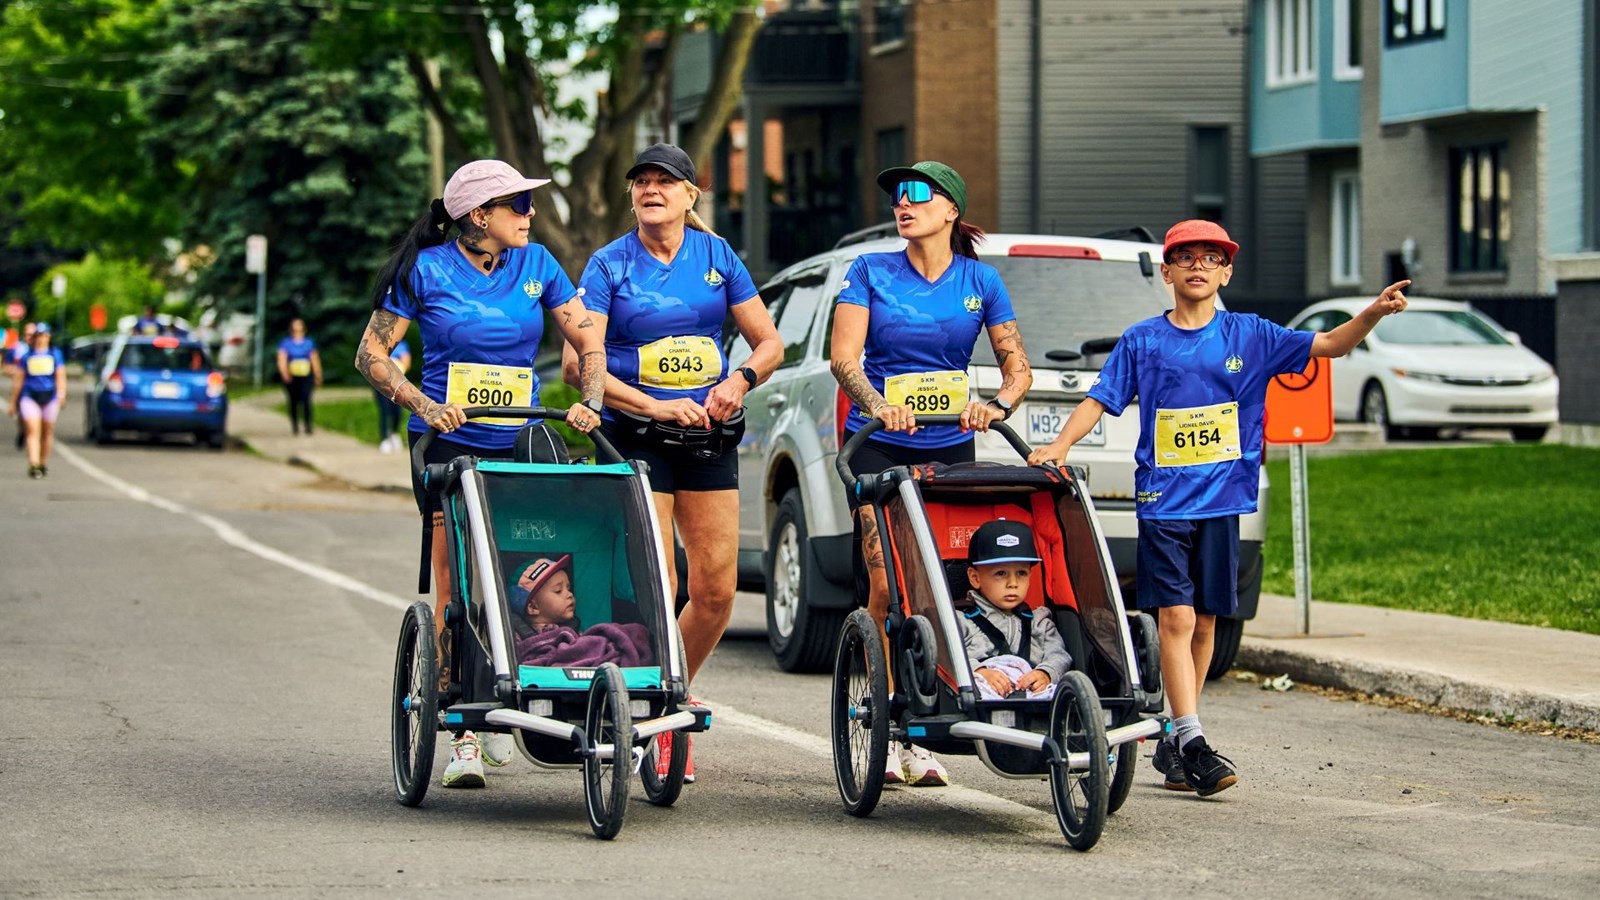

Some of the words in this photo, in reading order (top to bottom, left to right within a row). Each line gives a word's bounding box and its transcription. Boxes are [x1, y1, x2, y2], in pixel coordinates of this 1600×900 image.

[658, 356, 703, 373] 6343
[467, 387, 513, 407] 6900
[904, 394, 950, 411] 6899
[1031, 414, 1061, 434] W92
[1174, 427, 1221, 448] 6154
[571, 670, 596, 679] THU
